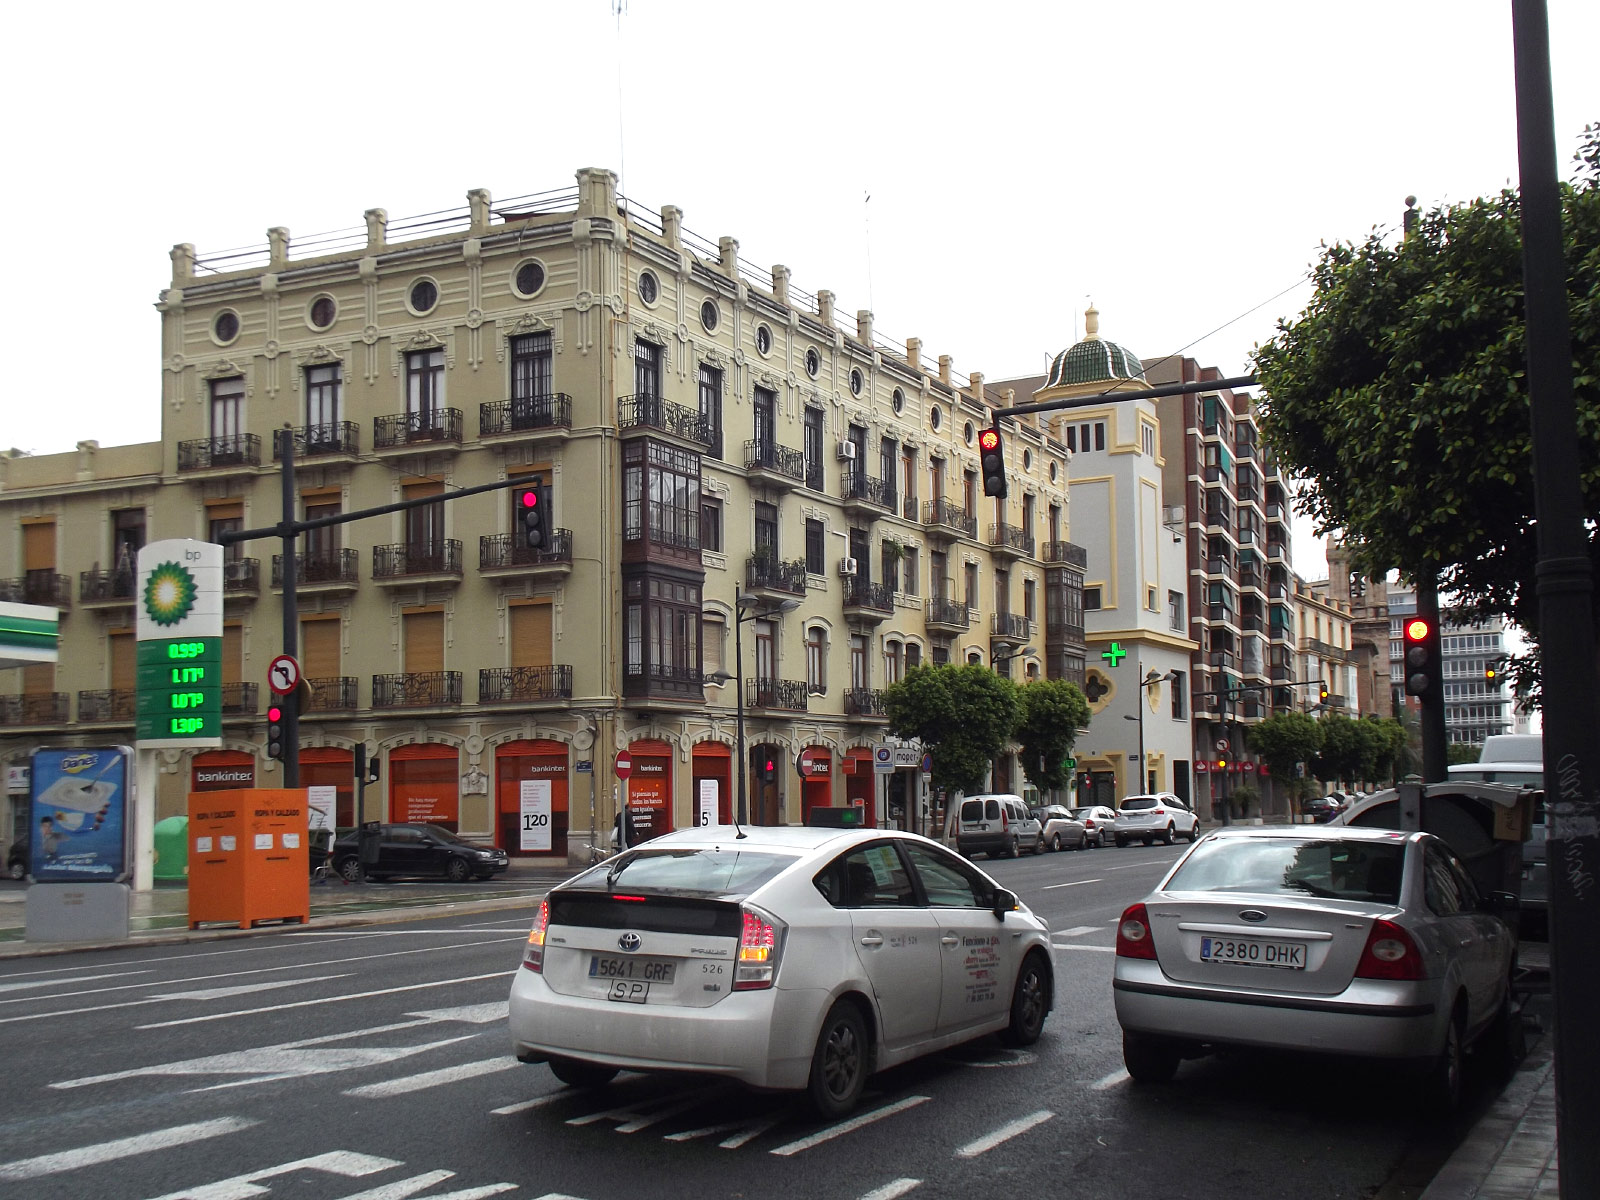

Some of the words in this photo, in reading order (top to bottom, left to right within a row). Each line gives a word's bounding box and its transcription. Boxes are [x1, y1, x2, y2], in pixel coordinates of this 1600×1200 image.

[185, 548, 202, 562] bp
[1213, 941, 1259, 960] 2380
[1265, 945, 1300, 964] DHK
[600, 959, 634, 977] 5641
[644, 962, 673, 981] GRF
[702, 963, 723, 975] 526
